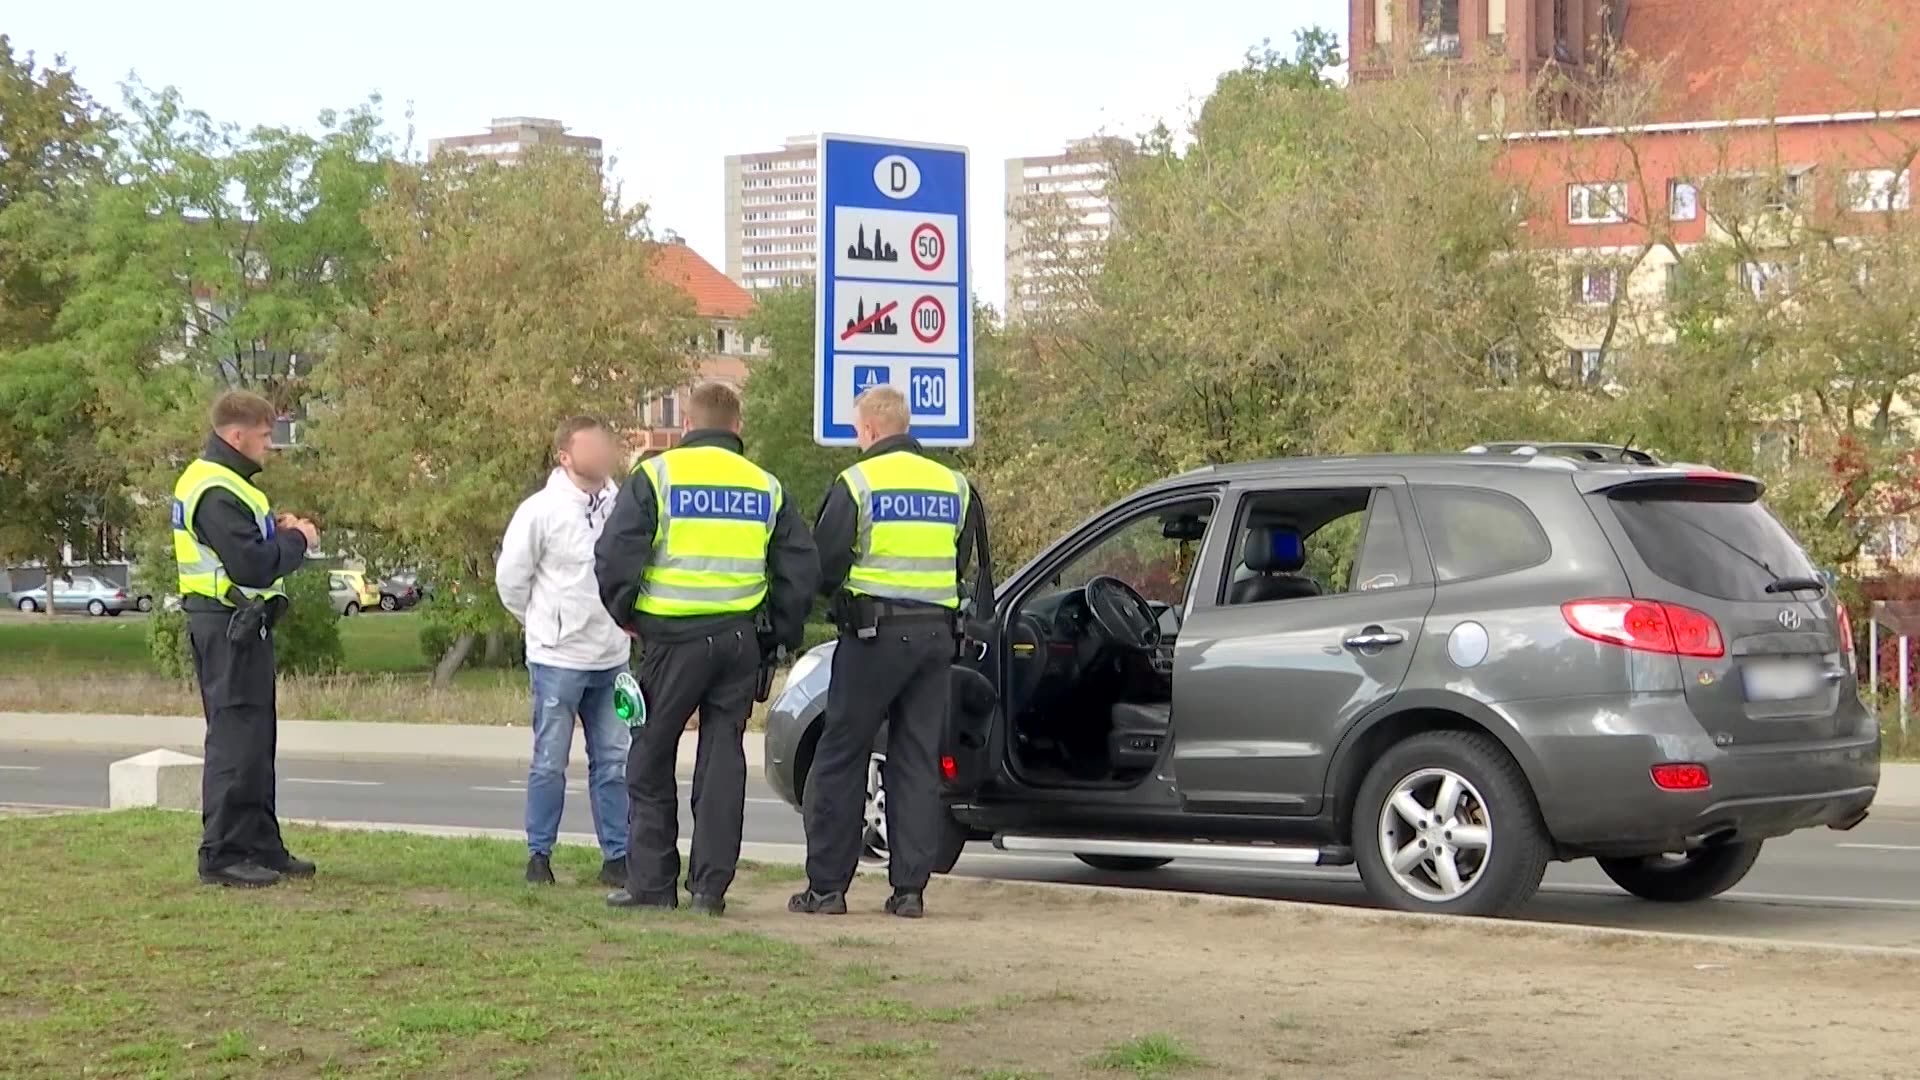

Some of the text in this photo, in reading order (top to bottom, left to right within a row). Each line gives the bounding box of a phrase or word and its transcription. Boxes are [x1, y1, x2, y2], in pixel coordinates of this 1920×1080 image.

[891, 161, 906, 192] D
[918, 236, 938, 258] 50
[918, 308, 939, 331] 100
[912, 374, 944, 409] 130
[679, 490, 763, 515] POLIZEI
[880, 495, 955, 518] POLIZEI
